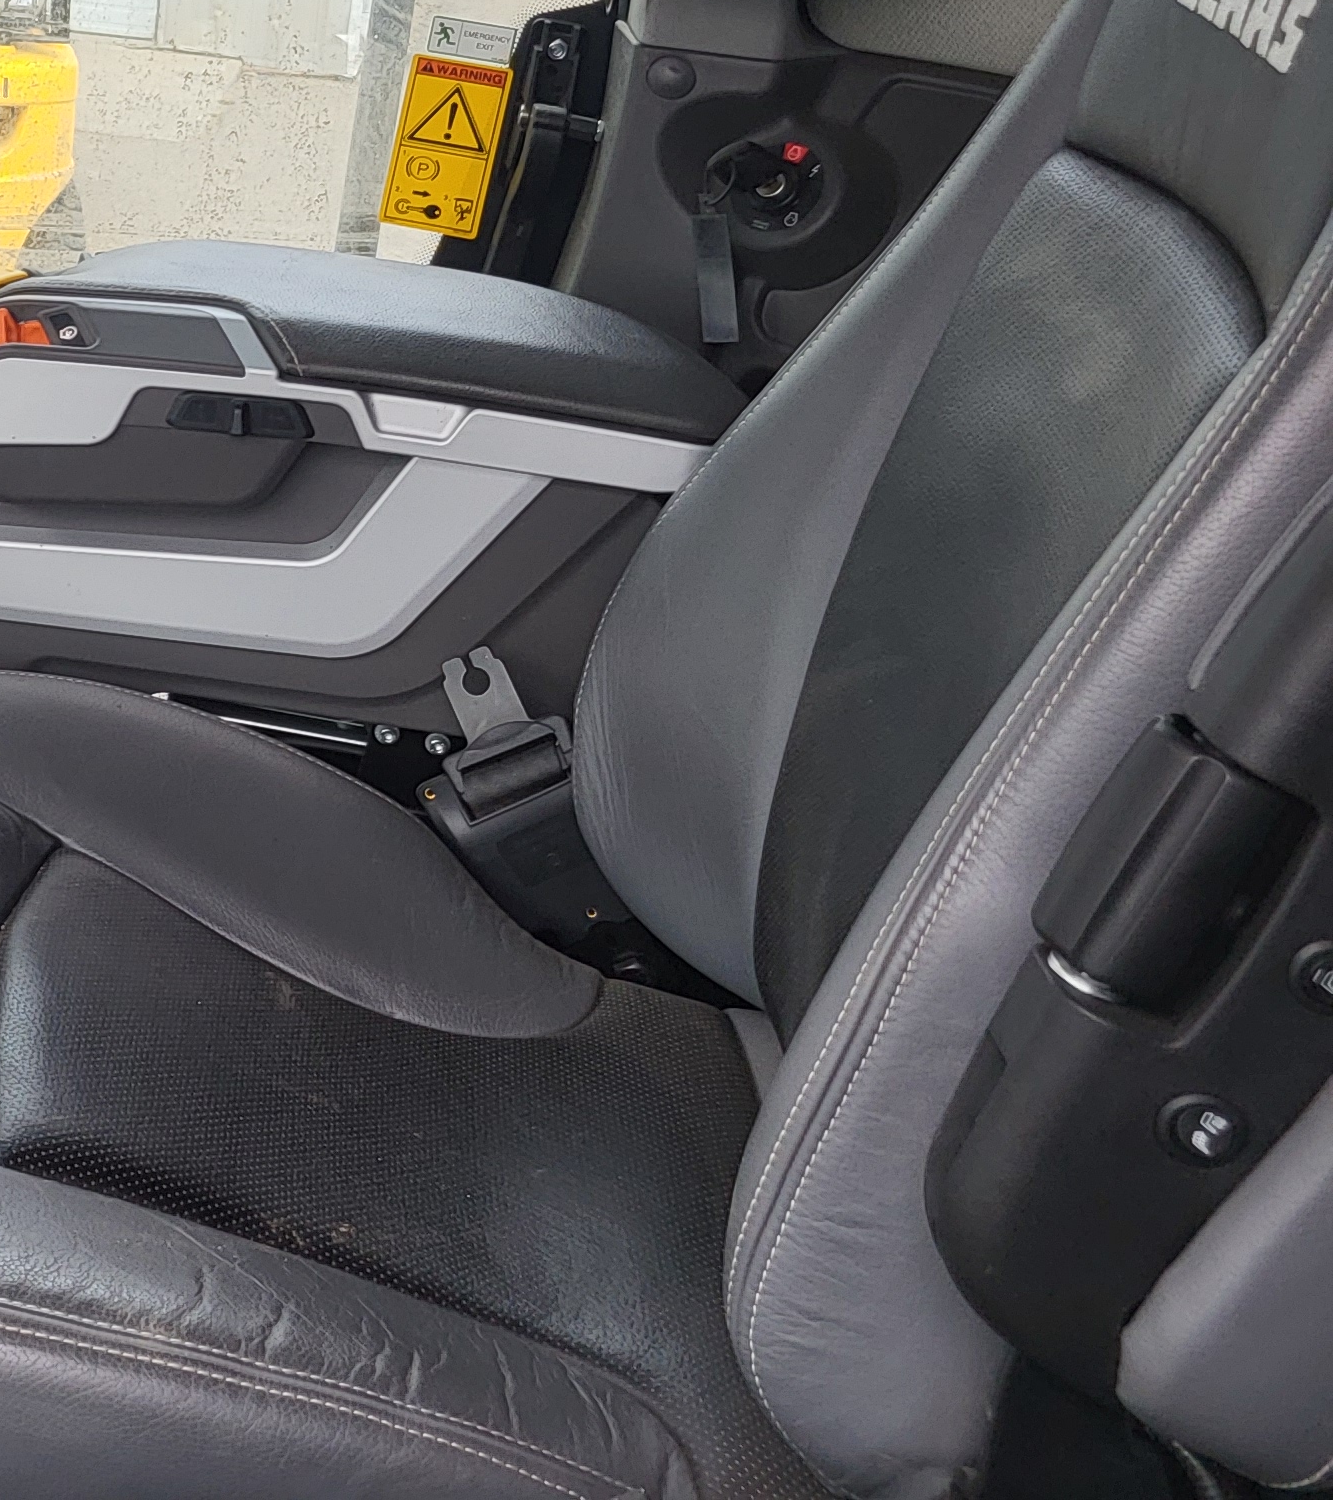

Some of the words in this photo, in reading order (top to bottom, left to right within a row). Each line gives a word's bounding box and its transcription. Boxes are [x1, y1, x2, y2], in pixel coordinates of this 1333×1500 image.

[464, 30, 511, 44] EMERGENCY
[476, 42, 495, 51] EXIT
[437, 64, 503, 85] WARNING
